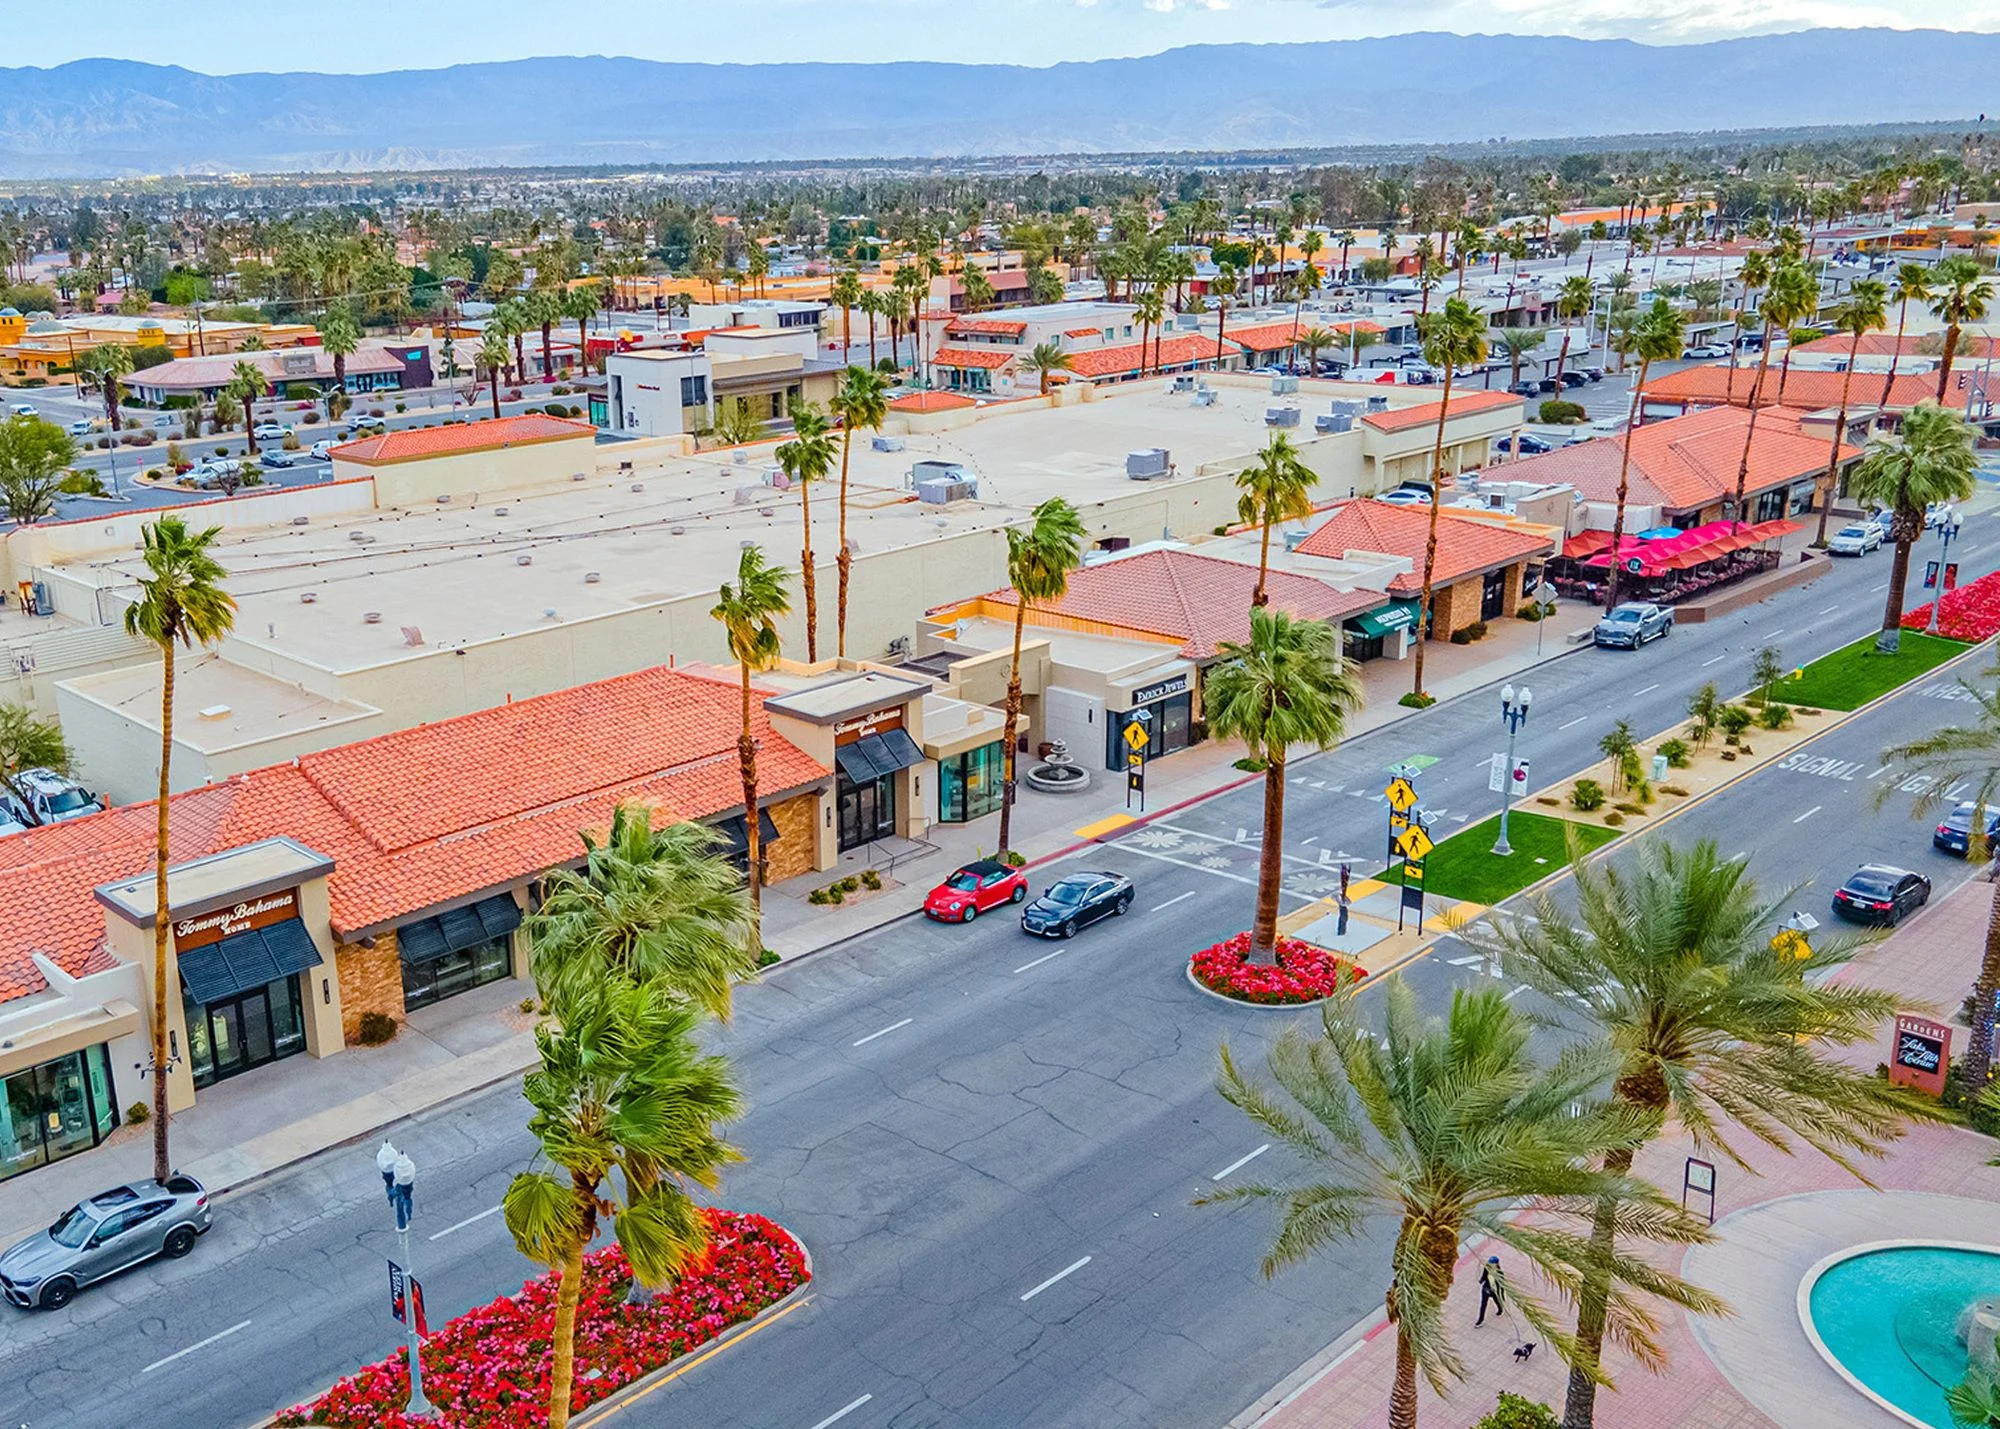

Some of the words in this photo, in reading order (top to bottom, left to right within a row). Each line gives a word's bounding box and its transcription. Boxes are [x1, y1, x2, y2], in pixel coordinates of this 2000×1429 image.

[867, 709, 901, 725] Bahama
[1778, 753, 1864, 781] SIGNAL
[177, 912, 231, 937] Tommy
[231, 895, 294, 921] Bahama
[1899, 1018, 1946, 1039] GARDENS
[1900, 1036, 1926, 1052] Saks
[1898, 1050, 1935, 1069] Avenue
